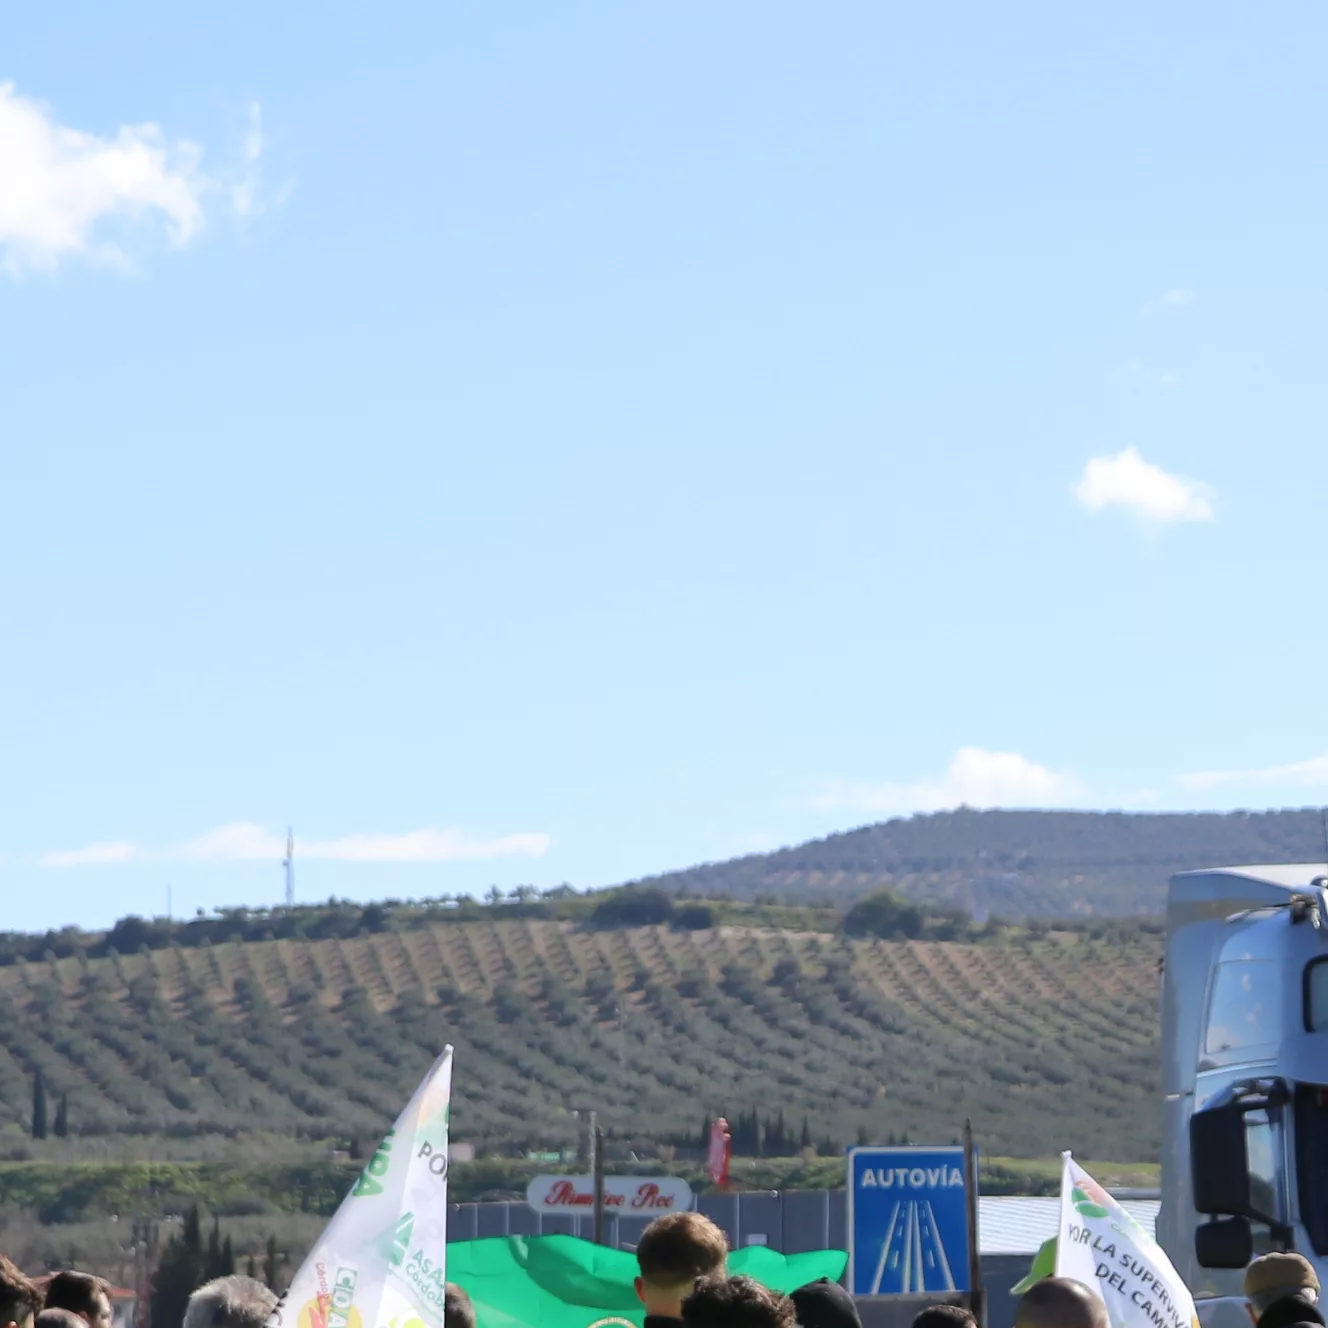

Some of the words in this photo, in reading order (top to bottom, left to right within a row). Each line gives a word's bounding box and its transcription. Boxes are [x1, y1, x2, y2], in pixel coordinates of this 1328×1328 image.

[418, 1140, 448, 1183] PO
[861, 1164, 964, 1187] AUTOVÍA
[1093, 1235, 1117, 1259] LA
[405, 1262, 446, 1314] Córdob
[412, 1248, 446, 1290] ASA
[1094, 1262, 1128, 1296] DEL
